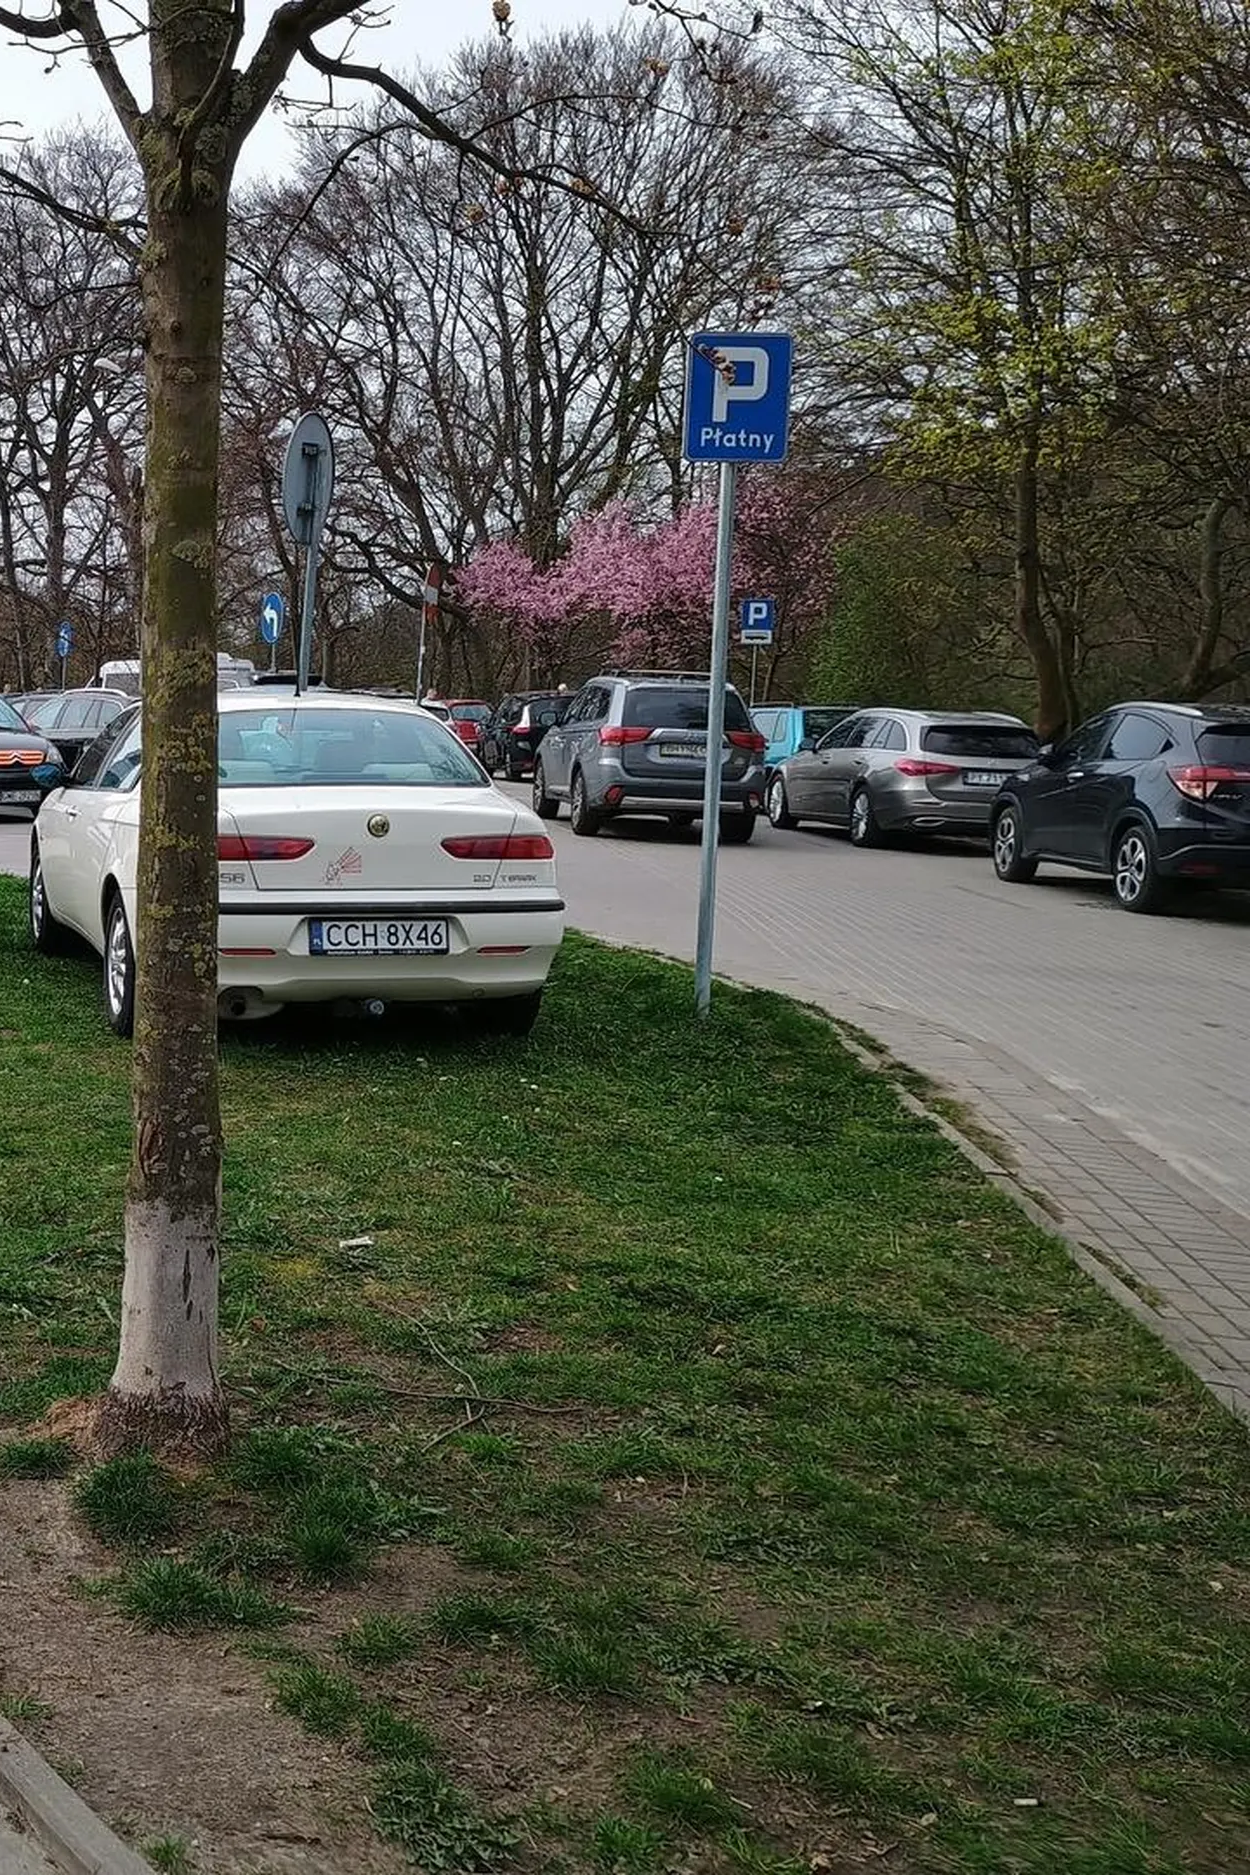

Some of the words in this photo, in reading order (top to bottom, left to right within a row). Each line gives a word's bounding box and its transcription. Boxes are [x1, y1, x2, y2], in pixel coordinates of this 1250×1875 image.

[712, 346, 770, 423] P
[700, 427, 775, 453] Płatny
[748, 602, 768, 626] P
[220, 872, 246, 884] 56
[326, 923, 379, 947] CCH
[386, 923, 444, 947] 8X46
